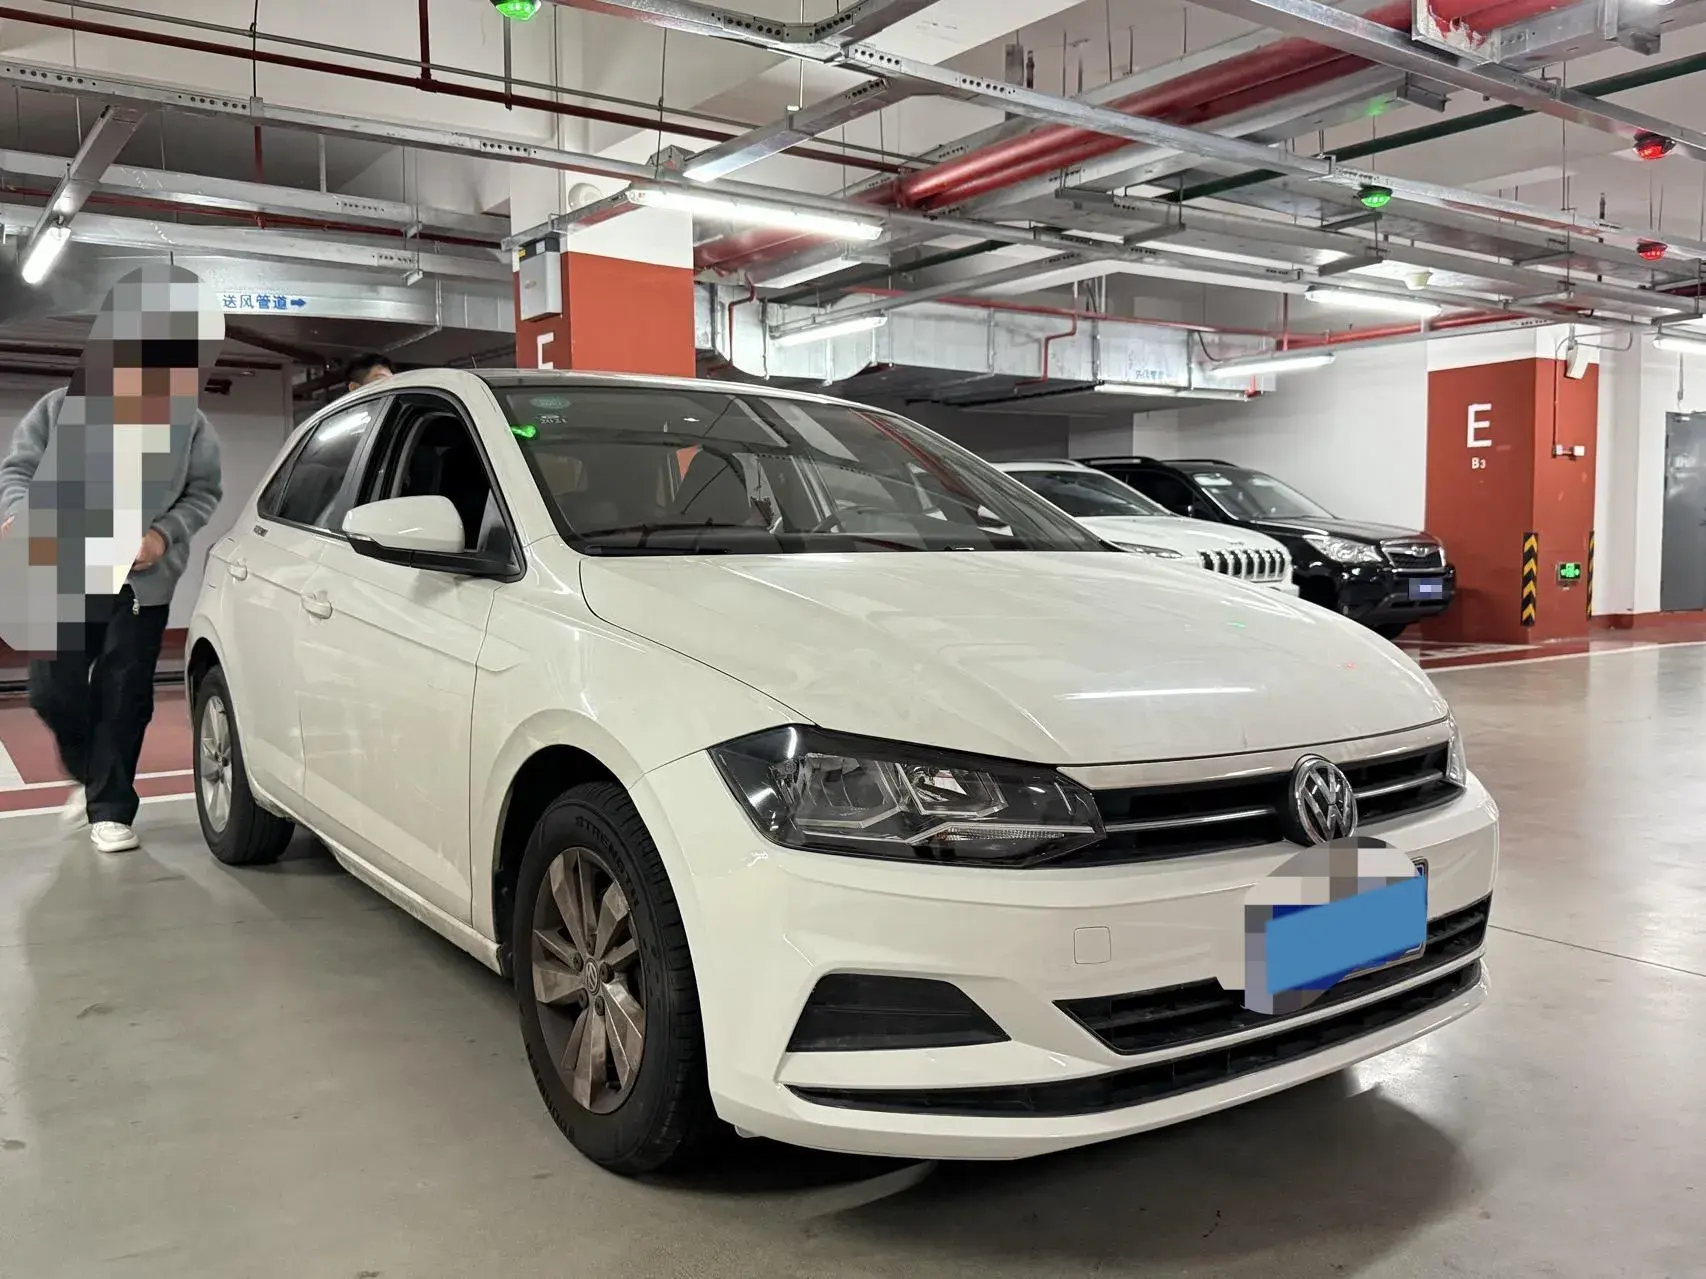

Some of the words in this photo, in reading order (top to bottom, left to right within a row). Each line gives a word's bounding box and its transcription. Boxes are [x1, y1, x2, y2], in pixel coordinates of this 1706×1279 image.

[223, 294, 287, 310] 送风管道
[1467, 403, 1492, 448] E
[1471, 457, 1486, 469] B3
